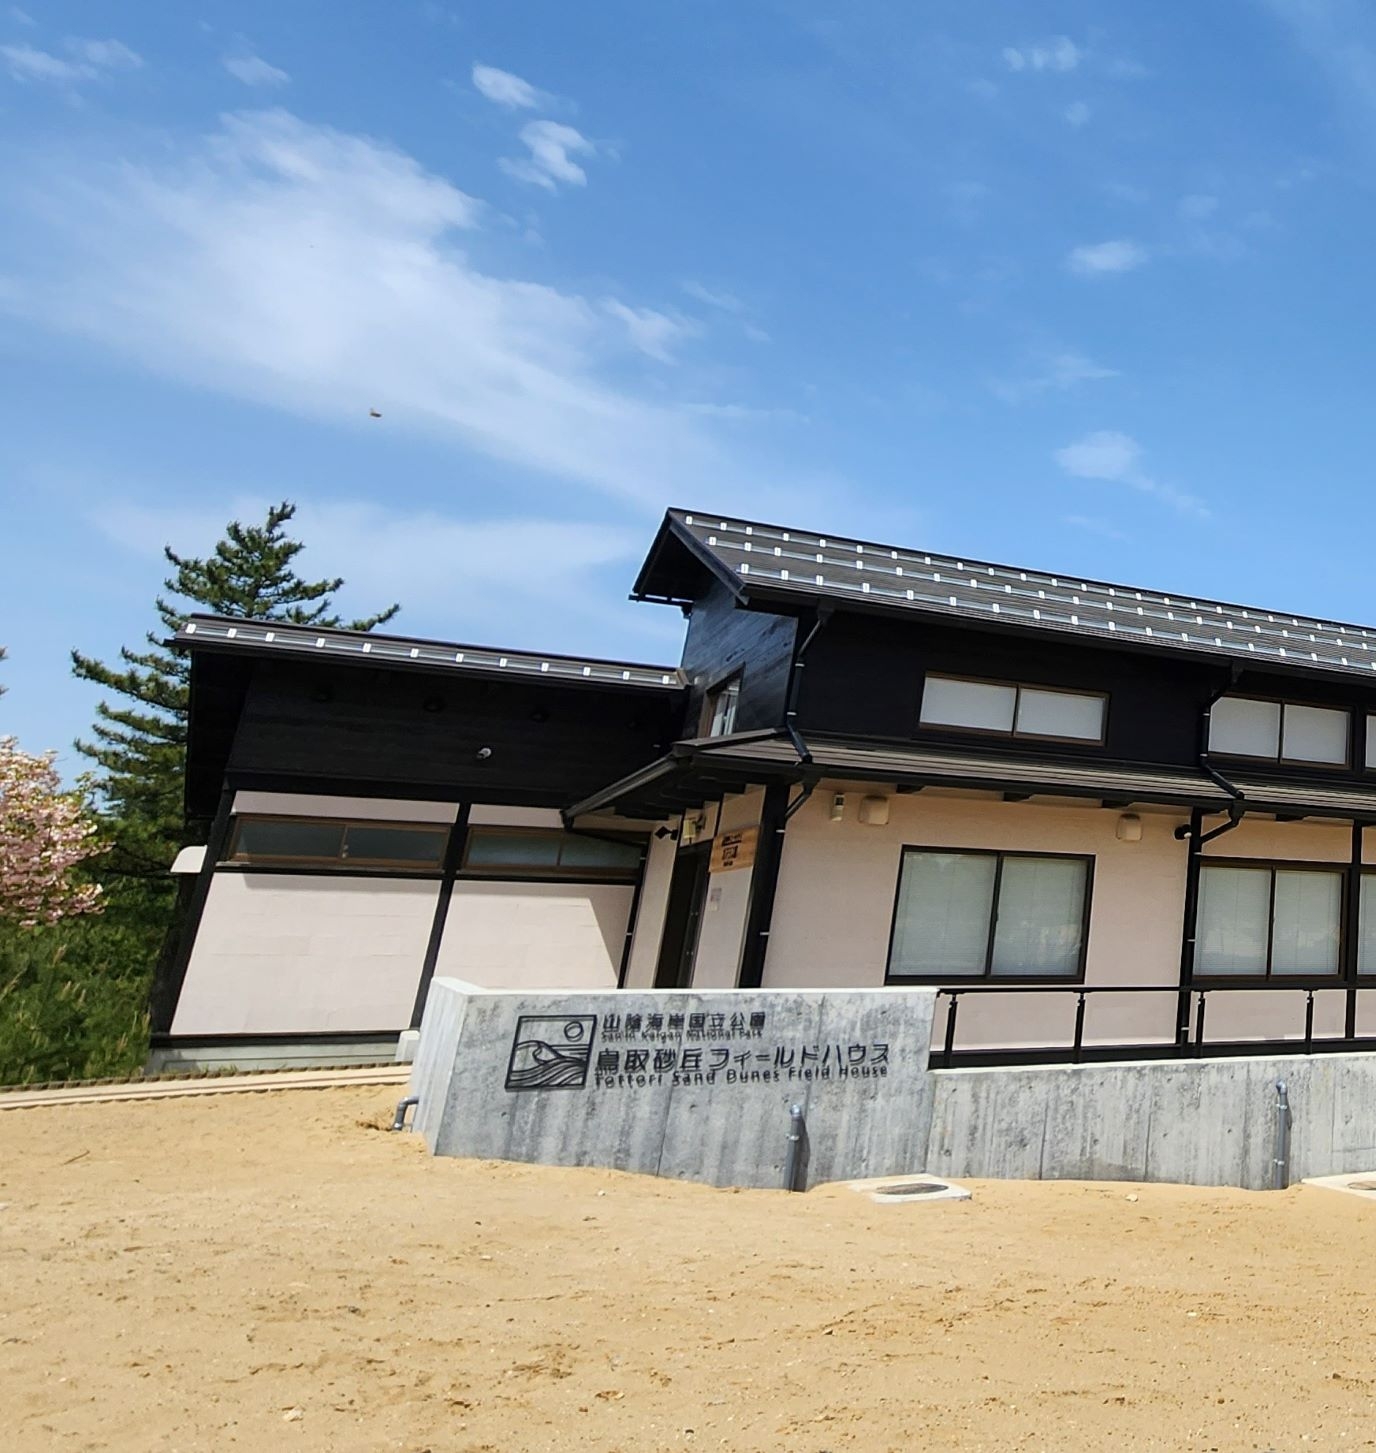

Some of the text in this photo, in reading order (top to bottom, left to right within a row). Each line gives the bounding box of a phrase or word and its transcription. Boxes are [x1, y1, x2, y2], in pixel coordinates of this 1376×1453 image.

[596, 1043, 889, 1074] 鳥取砂丘フィールドハウス
[594, 1065, 889, 1090] Tottori Sand Dunes Field House
